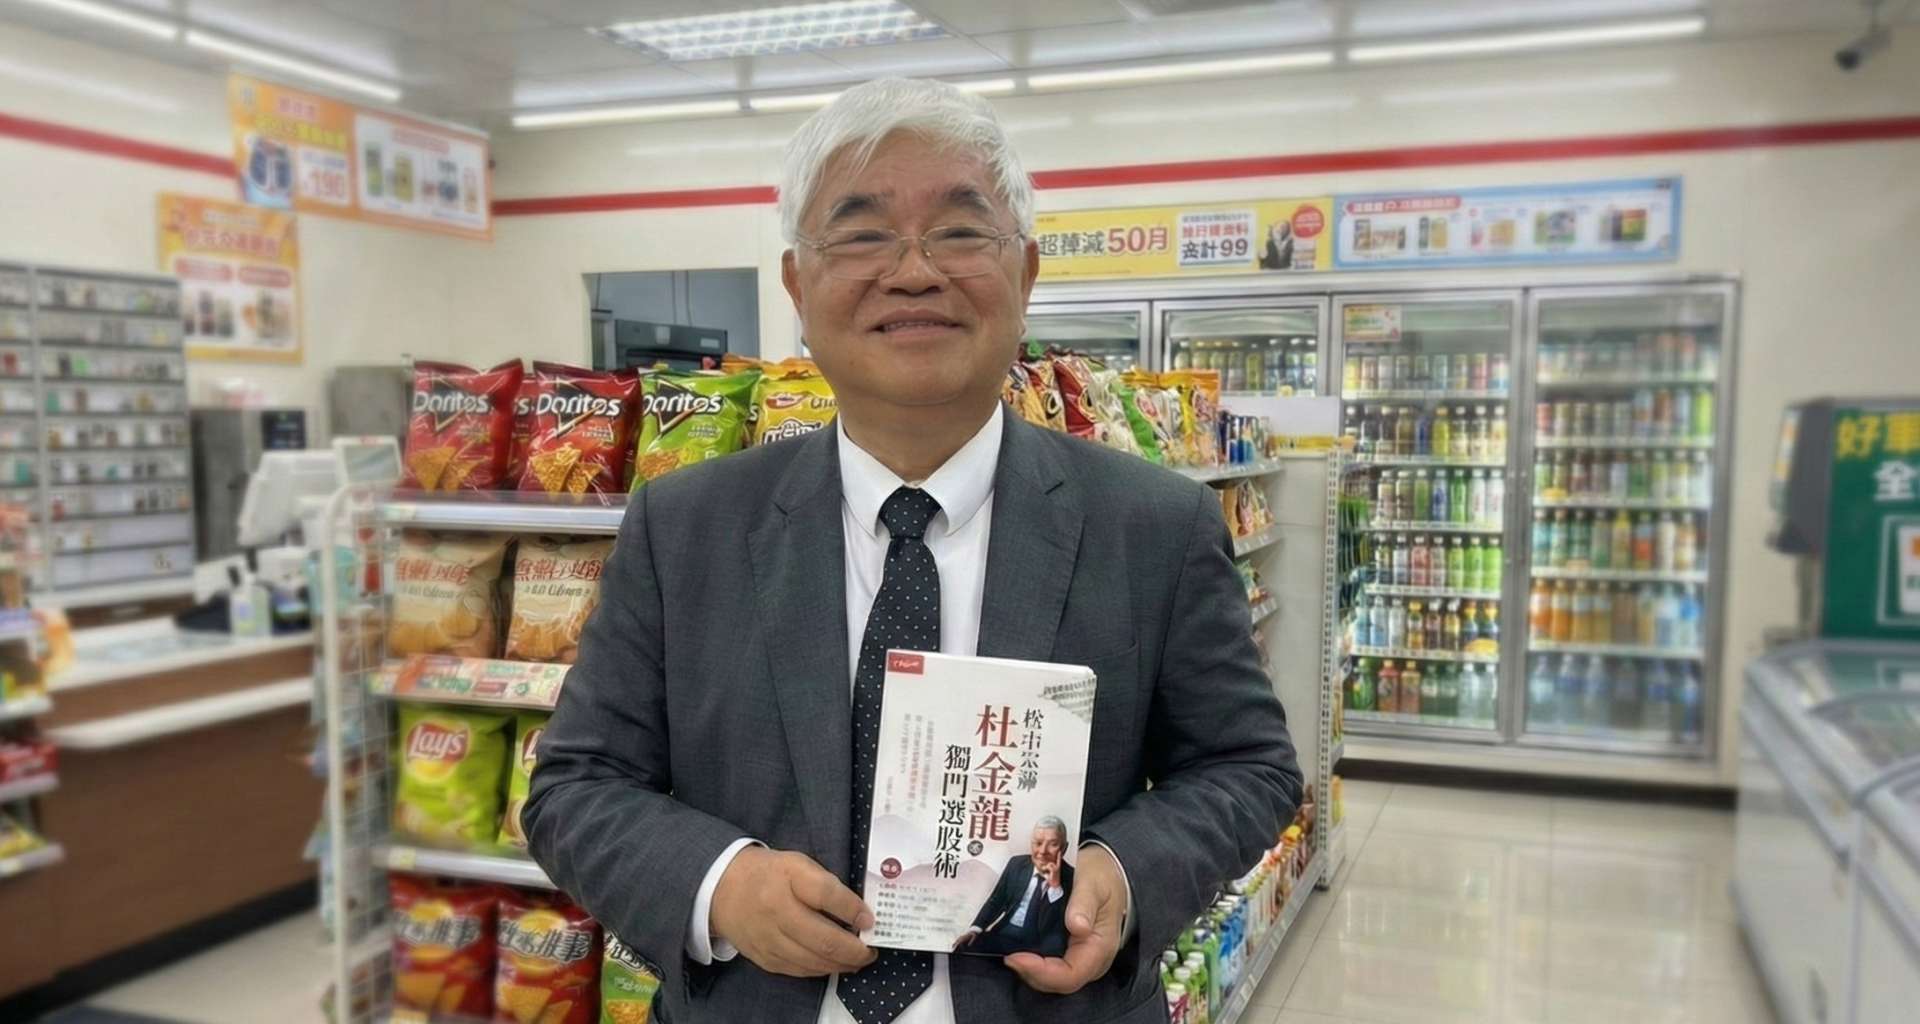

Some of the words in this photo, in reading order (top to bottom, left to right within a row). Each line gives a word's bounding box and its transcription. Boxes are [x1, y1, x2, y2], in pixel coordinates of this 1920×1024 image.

[413, 391, 489, 414] Doritos
[536, 394, 621, 416] Doritos
[933, 744, 972, 879] 獨門選股術
[968, 704, 1019, 842] 杜金龍
